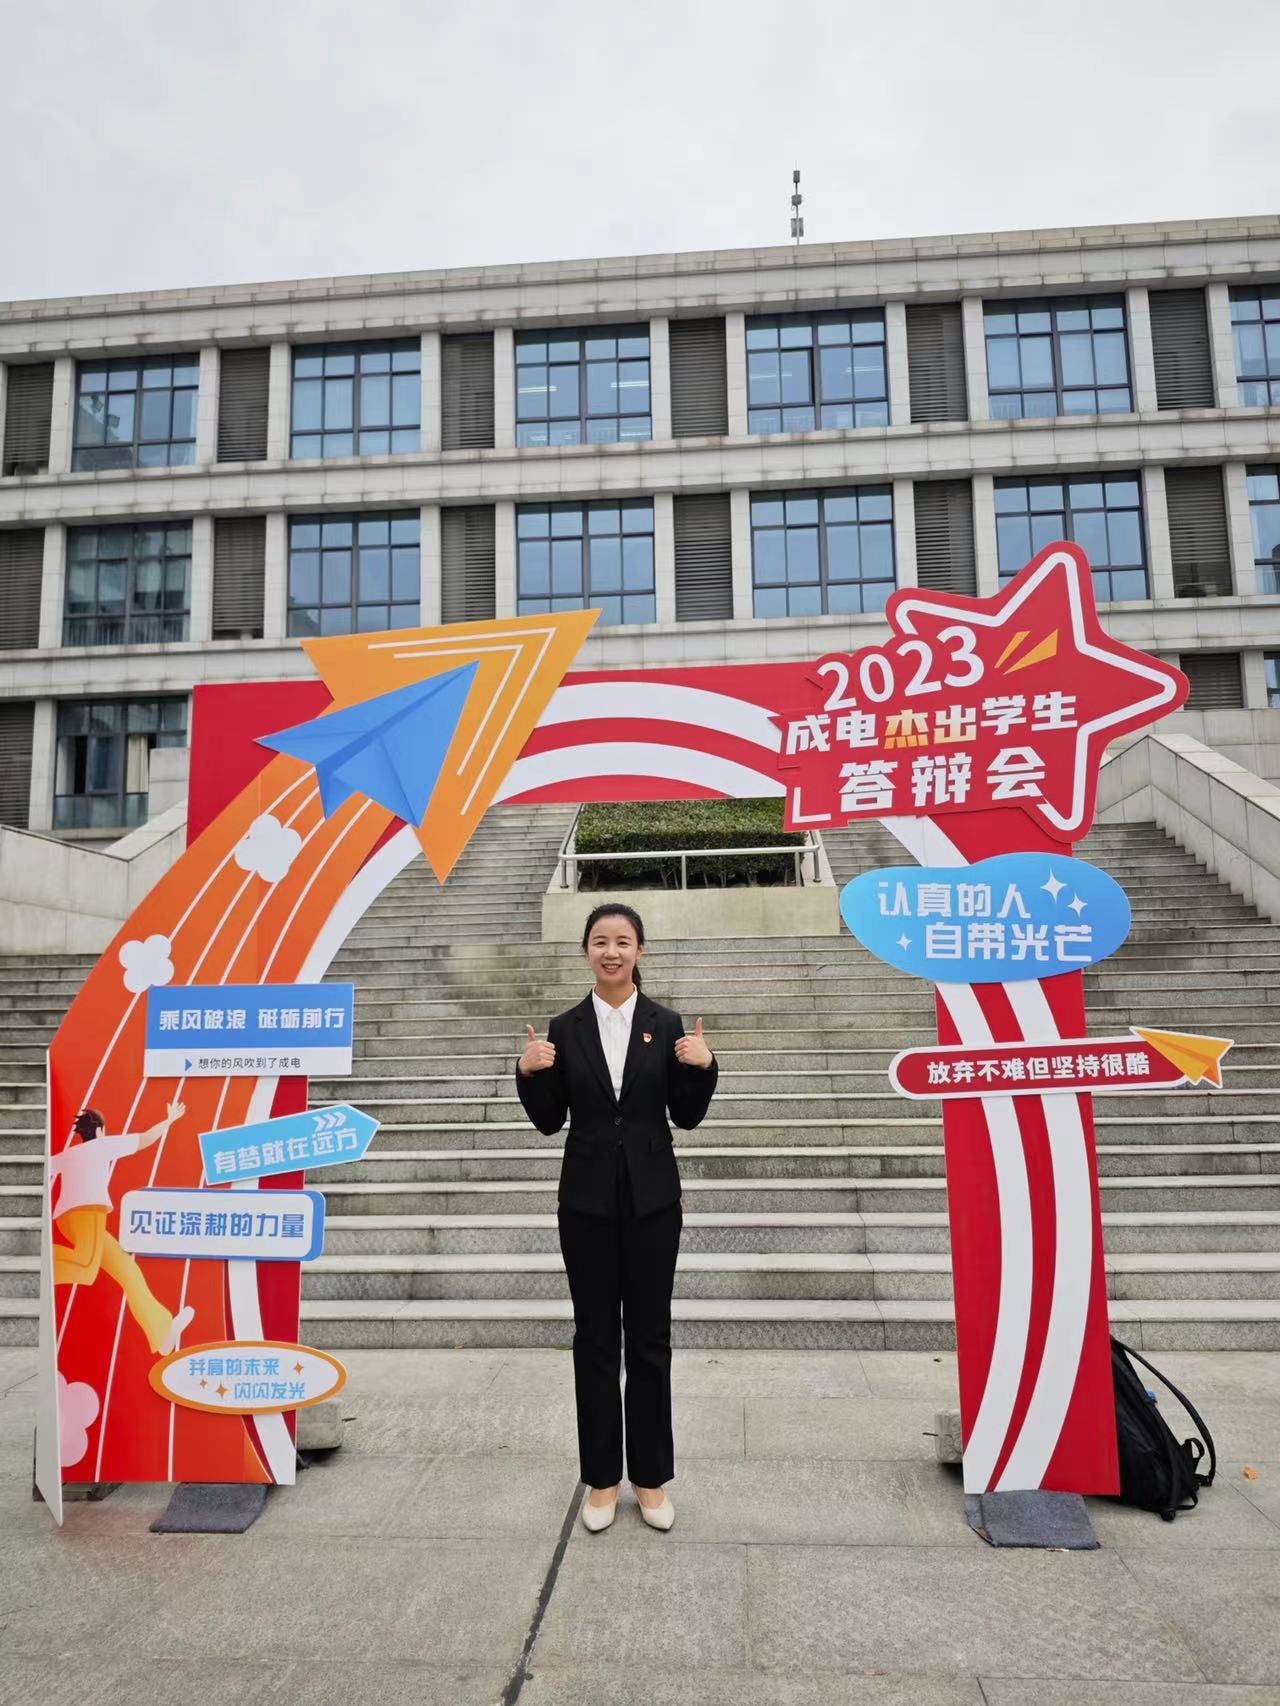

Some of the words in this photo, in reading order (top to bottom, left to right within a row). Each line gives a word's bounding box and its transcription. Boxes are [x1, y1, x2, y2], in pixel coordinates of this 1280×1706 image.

[817, 625, 985, 711] 2023
[785, 691, 1078, 755] 成电杰出学生
[839, 746, 1046, 813] 答辩会
[877, 881, 1031, 919] 认真的人
[925, 921, 1093, 963] 自带光芒
[159, 1009, 246, 1031] 乘风破浪
[258, 1007, 345, 1029] 砥砺前行
[198, 1056, 302, 1070] 想你的风吹到了成电
[926, 1052, 1150, 1085] 放弃不难但坚持很酷
[213, 1127, 359, 1175] 有梦就在远方
[130, 1210, 304, 1238] 见证深耕的力量
[188, 1358, 280, 1376] 并肩的未来
[233, 1382, 305, 1400] 闪闪发光
